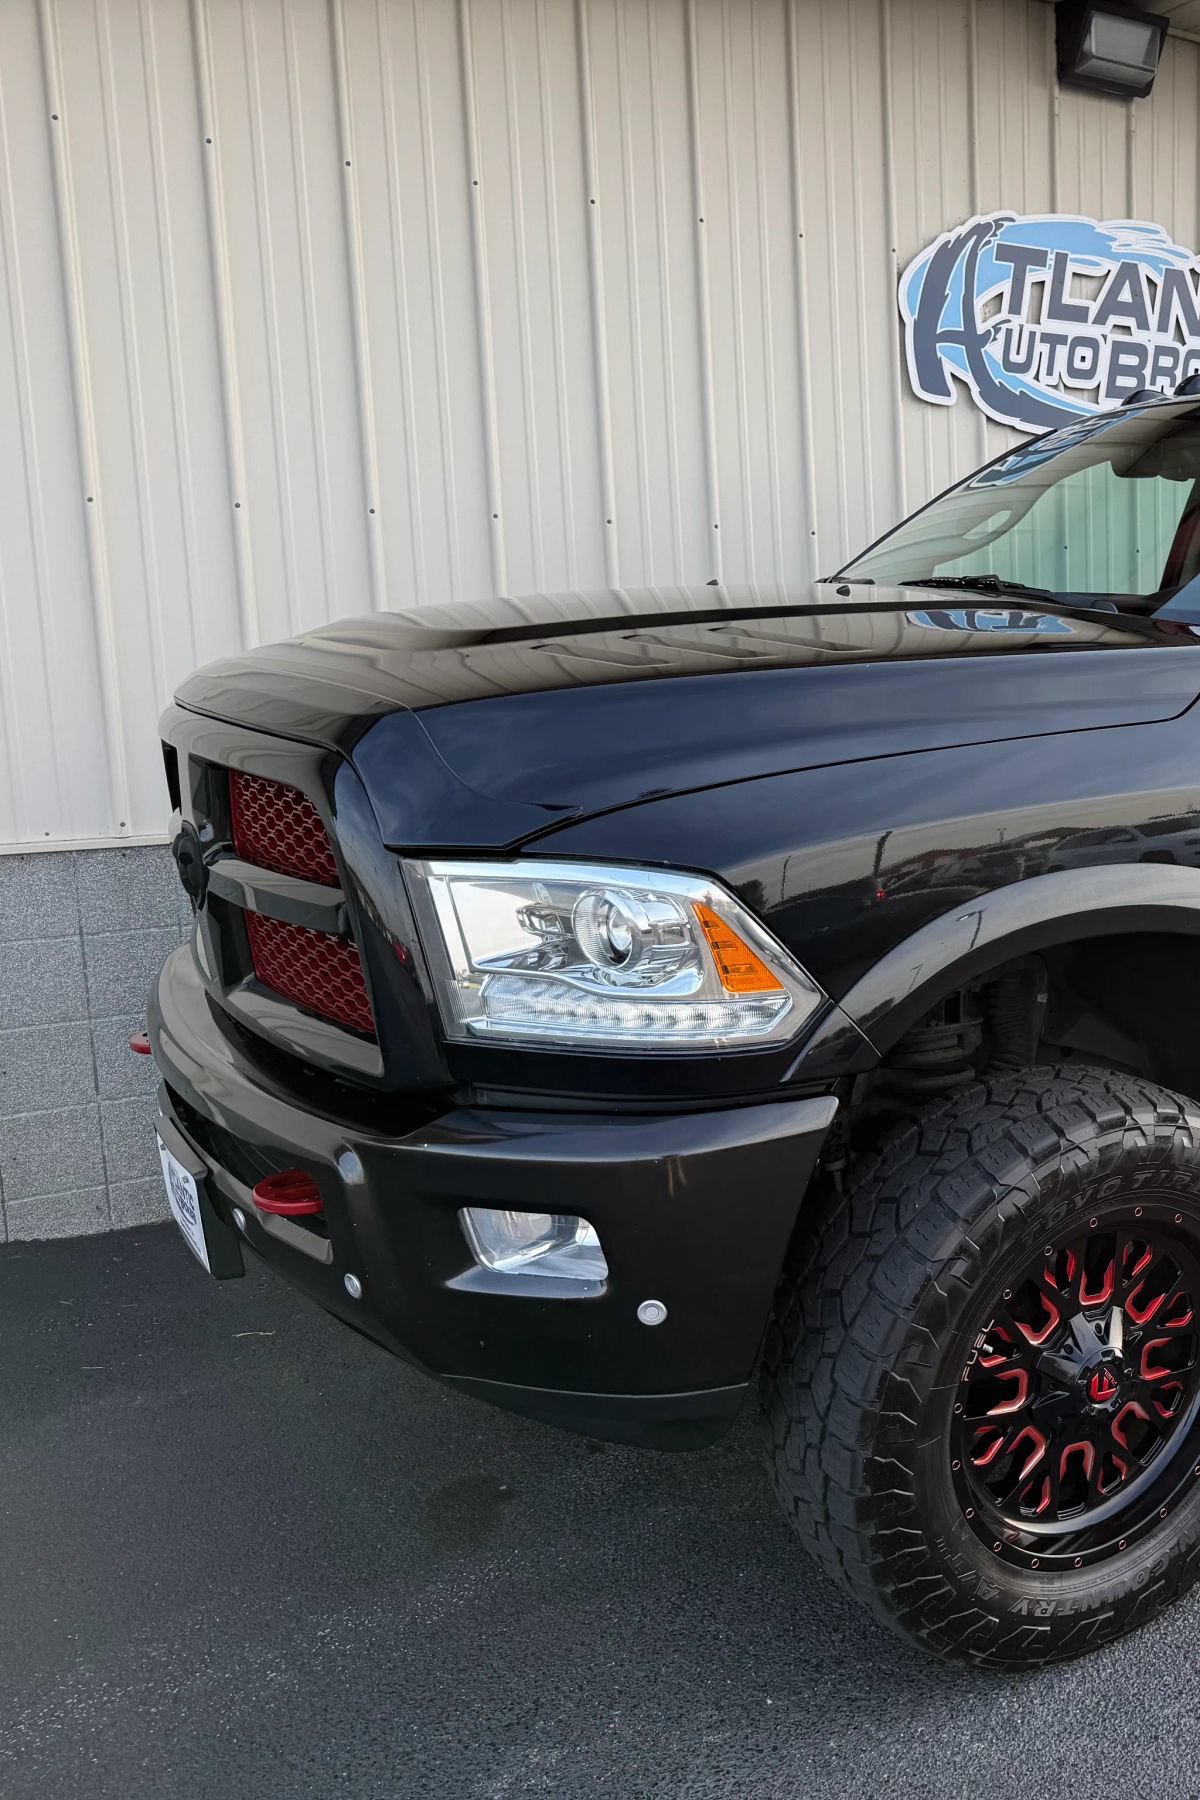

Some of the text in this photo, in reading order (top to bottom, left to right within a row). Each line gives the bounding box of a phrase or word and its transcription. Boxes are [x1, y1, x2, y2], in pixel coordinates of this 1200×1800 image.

[1020, 1174, 1123, 1250] TOYO
[961, 1319, 995, 1382] FUEL
[1007, 1548, 1171, 1618] COUNTRY
